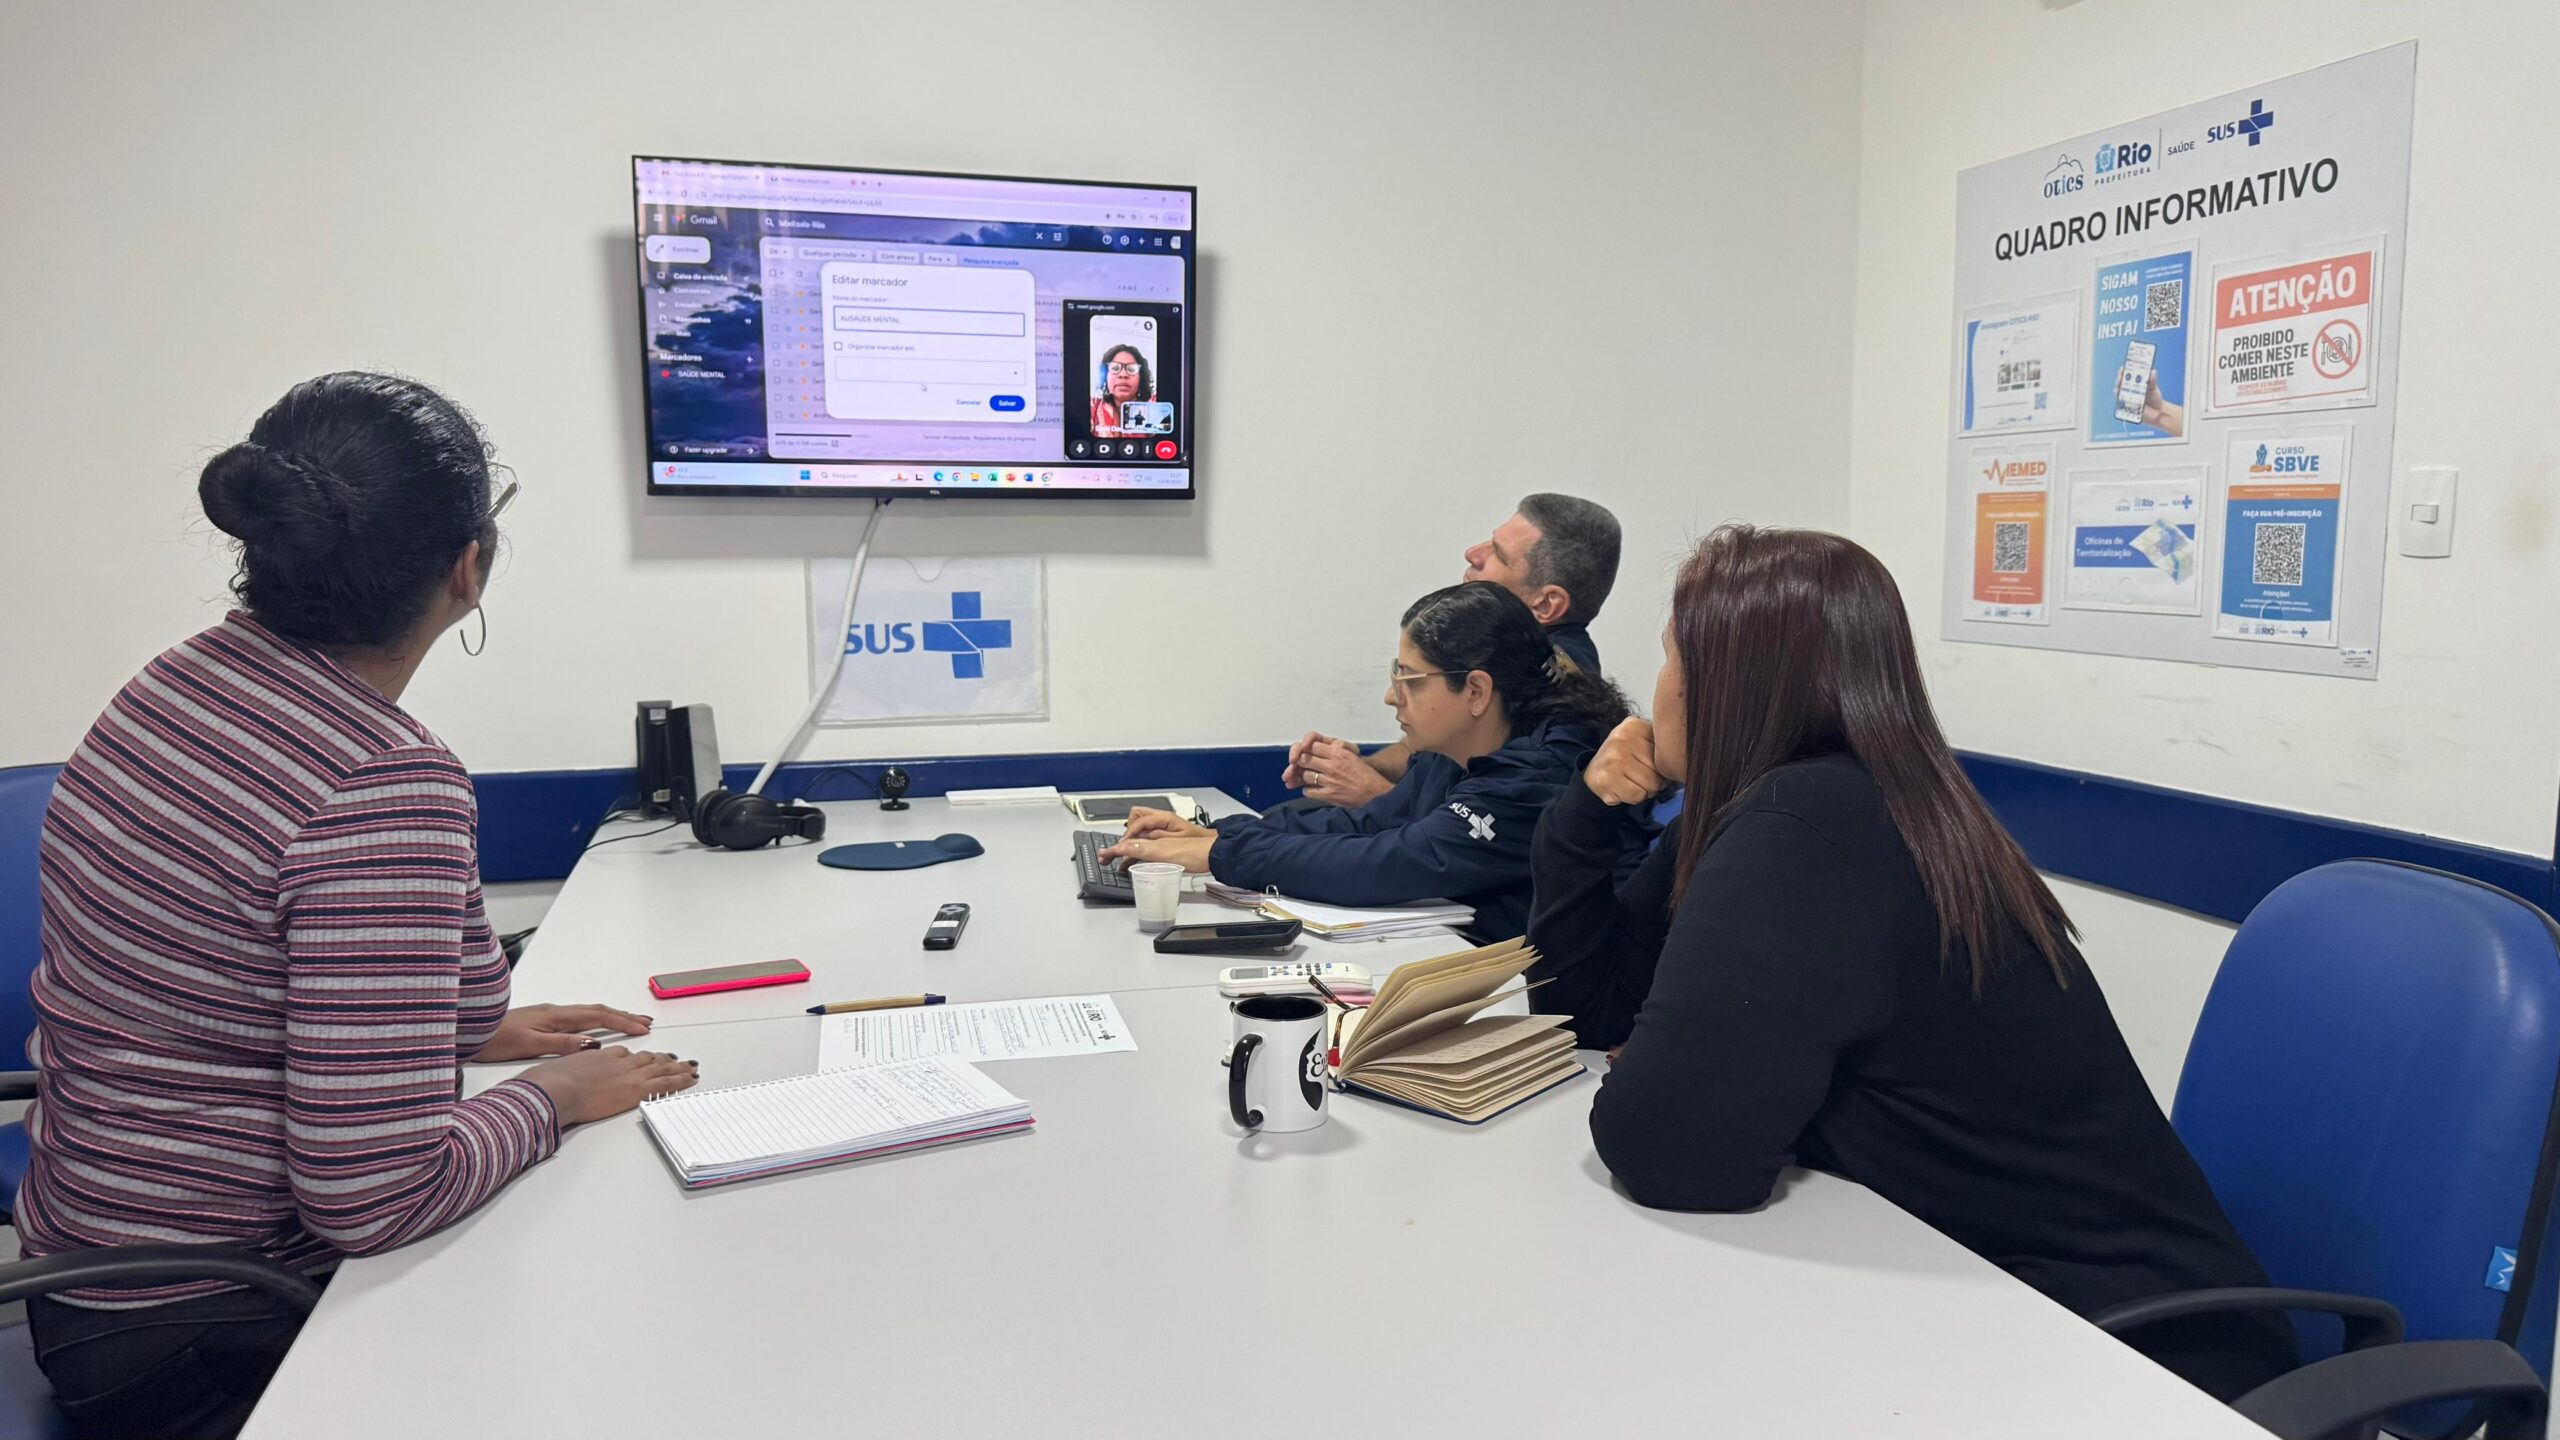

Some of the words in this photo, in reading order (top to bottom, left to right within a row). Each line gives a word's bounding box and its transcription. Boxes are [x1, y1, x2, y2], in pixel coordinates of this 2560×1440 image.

[2207, 121, 2235, 144] SUS
[2117, 142, 2152, 169] Rio
[2167, 140, 2195, 156] SAÚDE
[2094, 166, 2151, 186] PREFEITURA
[1995, 211, 2106, 261] QUADRO
[2115, 157, 2339, 236] INFORMATIVO
[690, 214, 718, 226] Gmail
[803, 249, 832, 258] Qualquer
[963, 256, 990, 266] Pesquisa
[673, 272, 692, 280] Caixa
[692, 272, 701, 280] de
[702, 273, 728, 281] entrada
[832, 274, 859, 285] Editar
[862, 276, 908, 287] marcador
[2101, 270, 2138, 291] SIGAM
[2228, 263, 2357, 319] ATENÇÃO
[1076, 303, 1115, 311] meet.google.com
[2099, 294, 2138, 316] NOSSO
[2233, 328, 2294, 352] PROIBIDO
[660, 353, 703, 362] Marcadores
[2219, 350, 2263, 370] COMER
[2266, 343, 2309, 363] NESTE
[678, 369, 699, 378] SAÚDE
[700, 370, 726, 379] MENTAL
[2231, 361, 2295, 384] AMBIENTE
[998, 399, 1017, 407] Salvar
[684, 446, 700, 455] Fazer
[702, 446, 728, 456] upgrade
[2275, 446, 2305, 455] CURSO
[2274, 456, 2319, 472] SBVE
[2084, 536, 2112, 545] Oficinas
[2113, 536, 2124, 545] de
[2076, 547, 2132, 560] Territorialização
[844, 622, 915, 656] SUS
[1448, 802, 1472, 818] SUS
